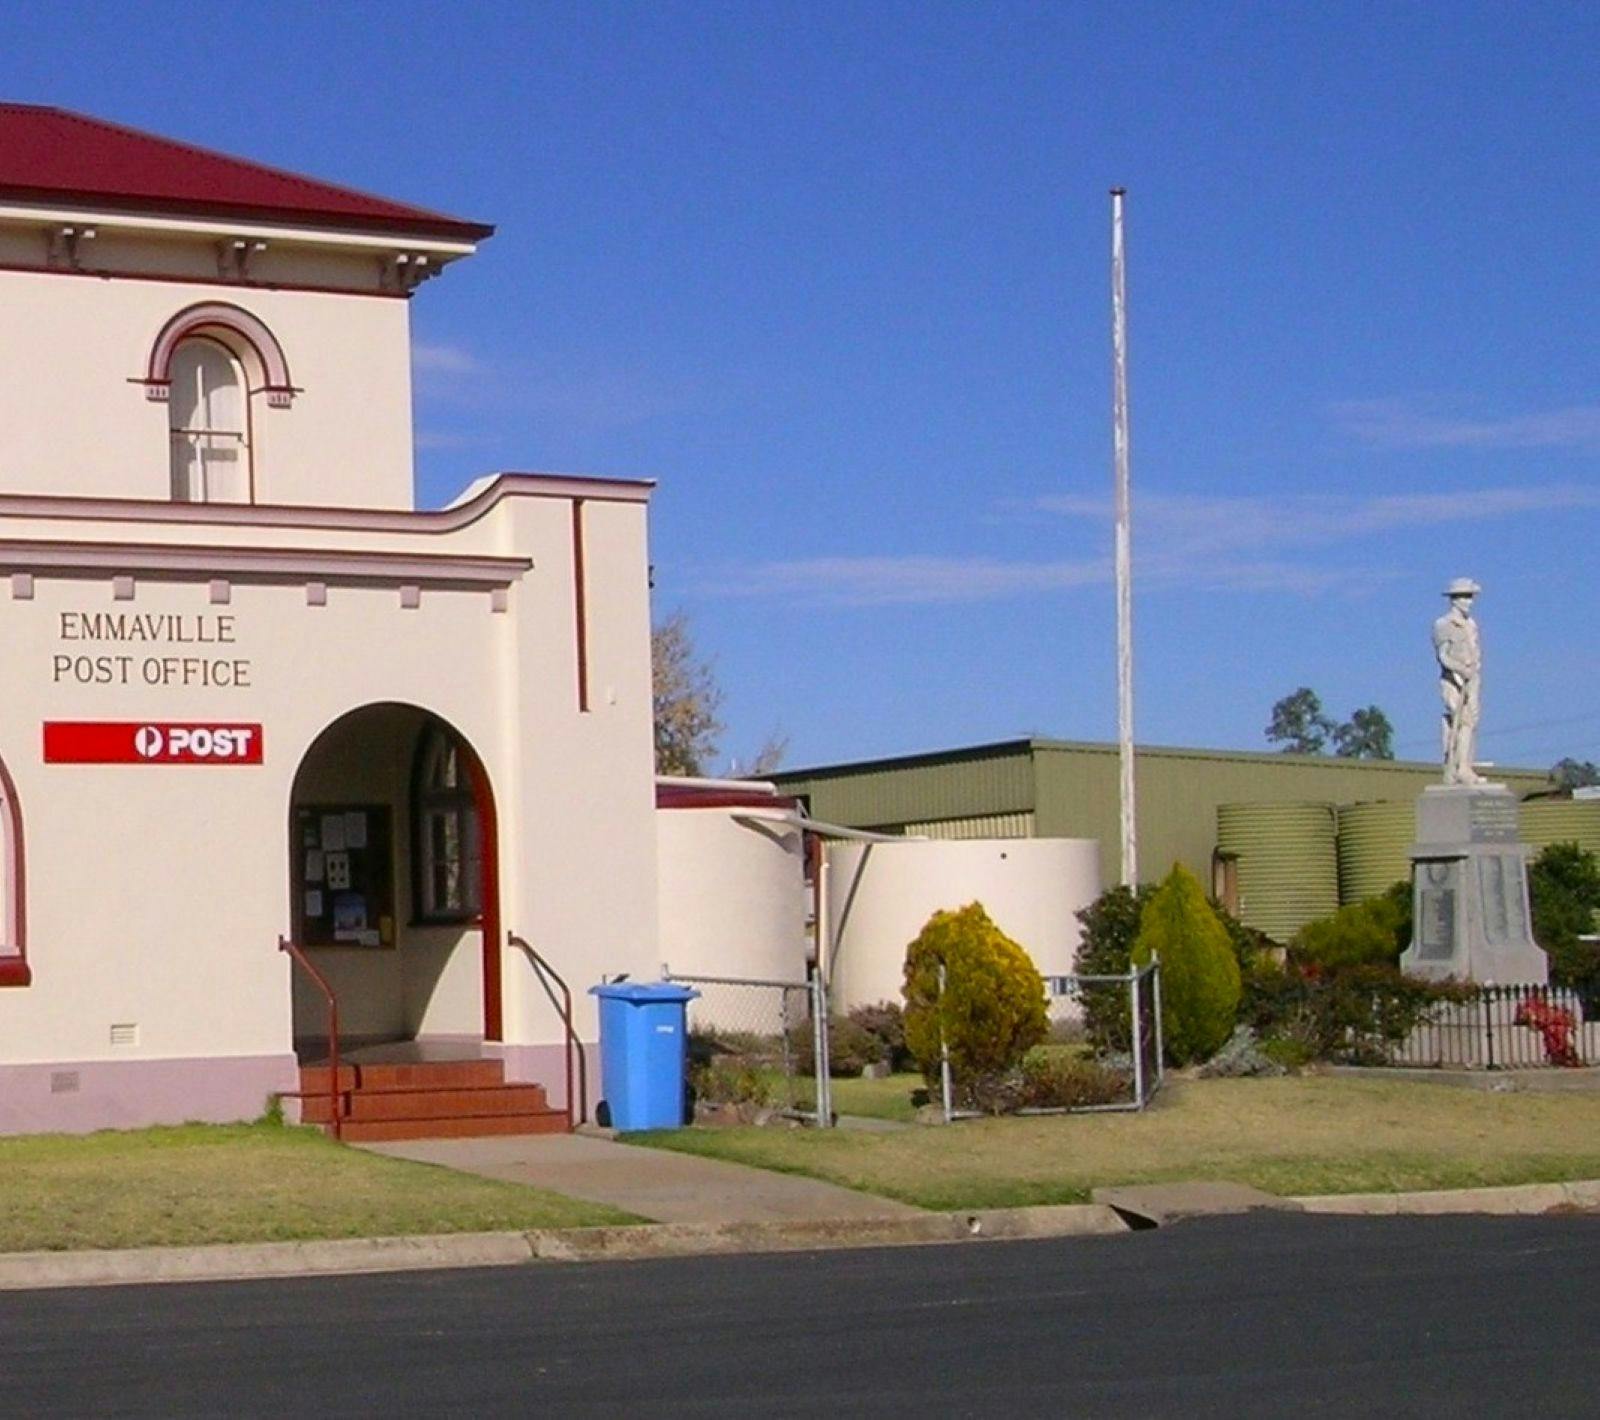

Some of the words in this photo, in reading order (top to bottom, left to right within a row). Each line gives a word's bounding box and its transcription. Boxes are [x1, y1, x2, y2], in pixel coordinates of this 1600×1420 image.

[60, 612, 236, 643] EMMAVILLE
[53, 655, 133, 684] POST
[142, 657, 251, 687] OFFICE
[168, 729, 253, 757] POST
